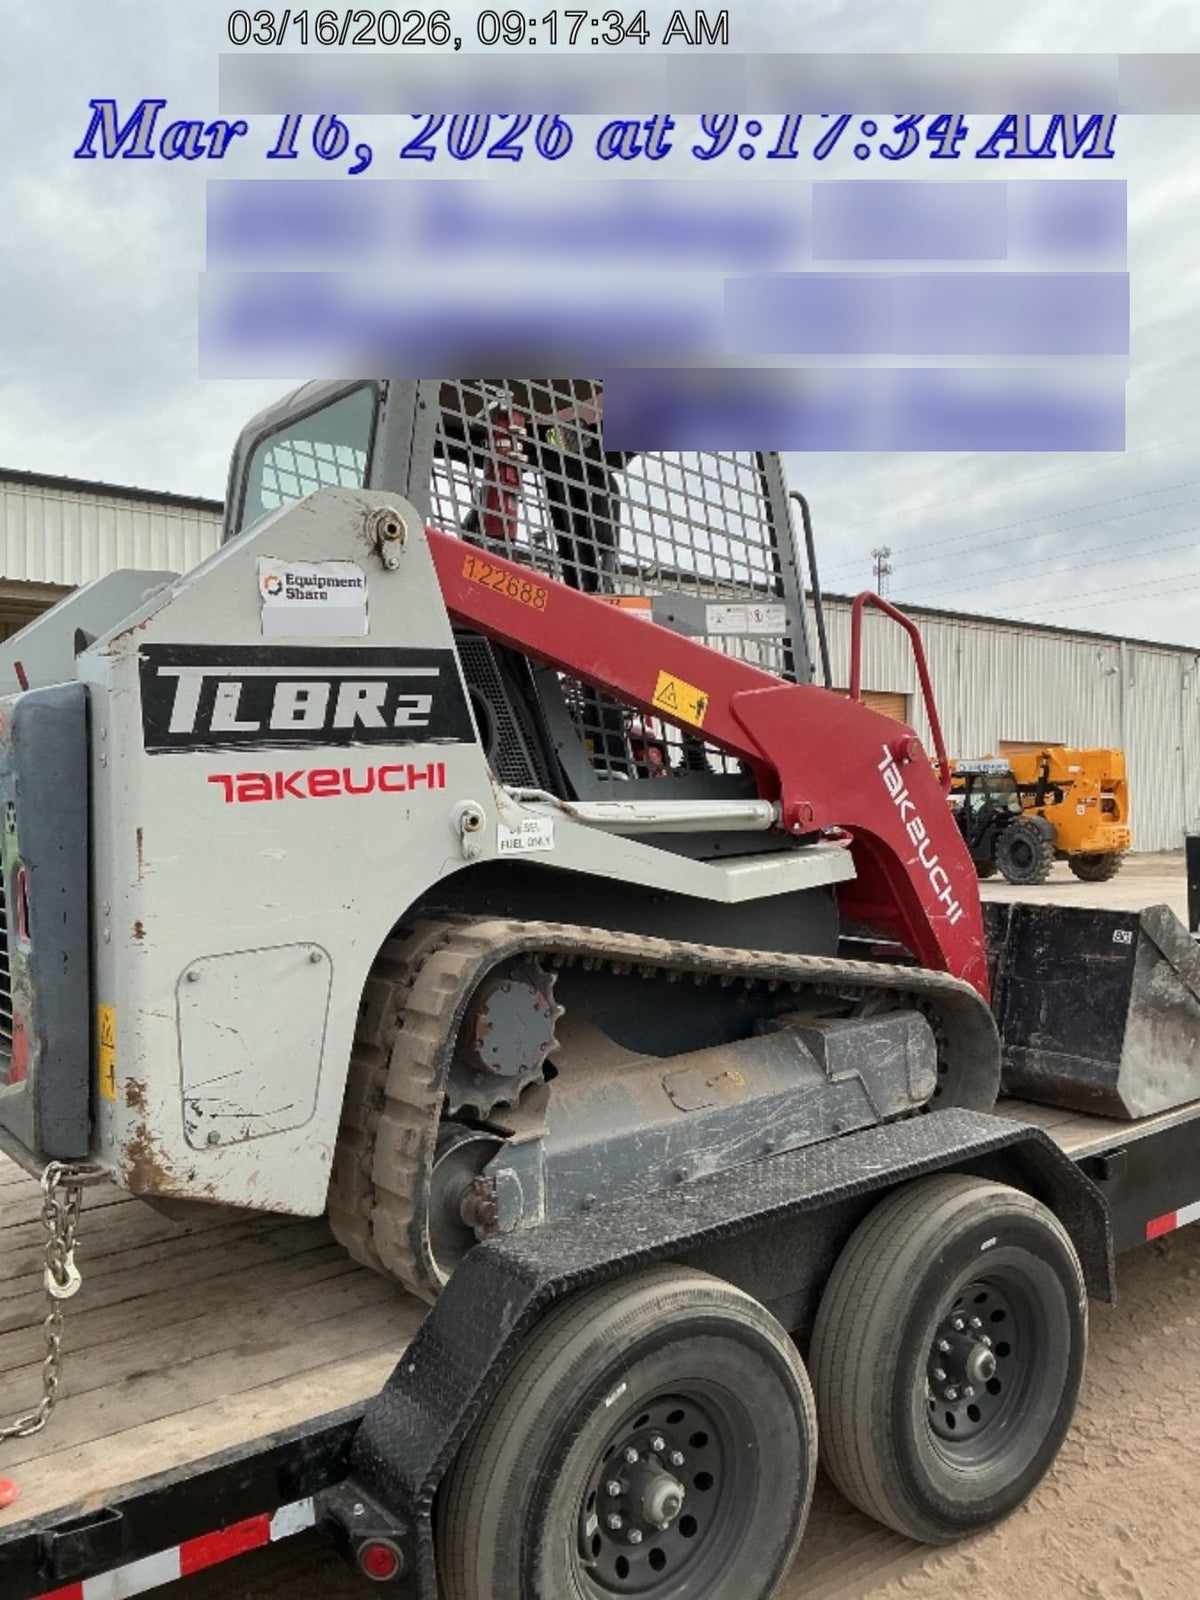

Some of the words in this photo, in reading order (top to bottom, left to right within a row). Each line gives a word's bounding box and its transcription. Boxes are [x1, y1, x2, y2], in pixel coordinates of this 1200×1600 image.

[285, 573, 362, 589] Equipment
[467, 559, 546, 608] 122688
[285, 588, 328, 601] Share
